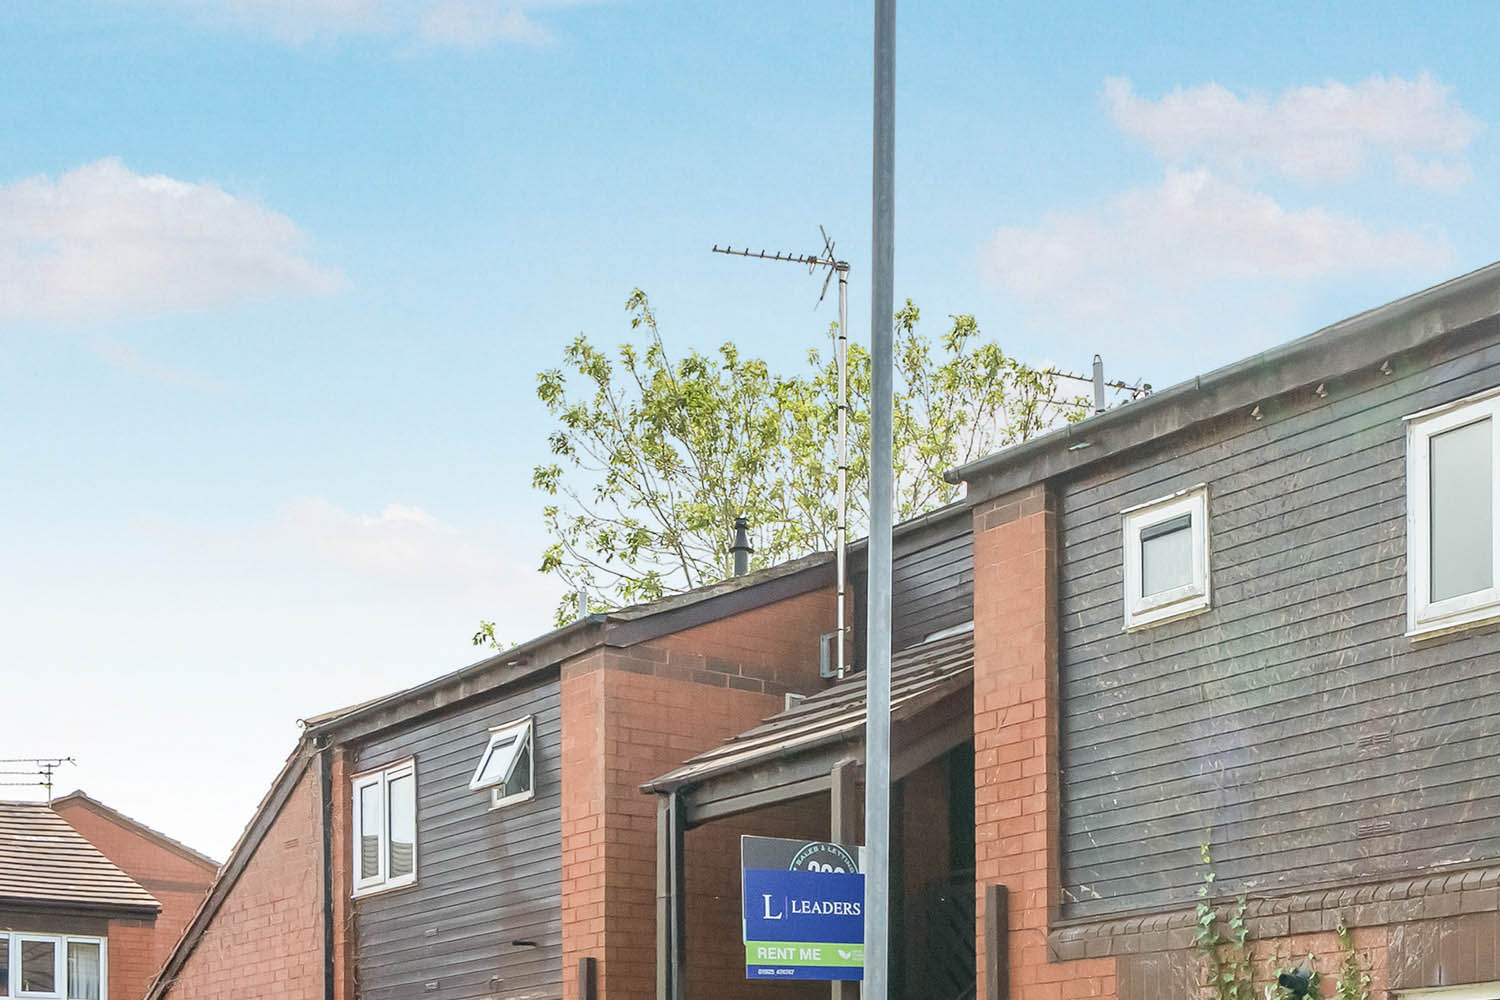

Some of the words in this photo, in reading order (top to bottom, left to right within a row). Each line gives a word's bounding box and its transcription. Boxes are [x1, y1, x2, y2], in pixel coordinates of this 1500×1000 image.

[827, 846, 856, 874] LETTING
[762, 894, 782, 919] L
[791, 900, 861, 916] LEADERS
[757, 946, 796, 961] RENT
[799, 948, 821, 961] ME
